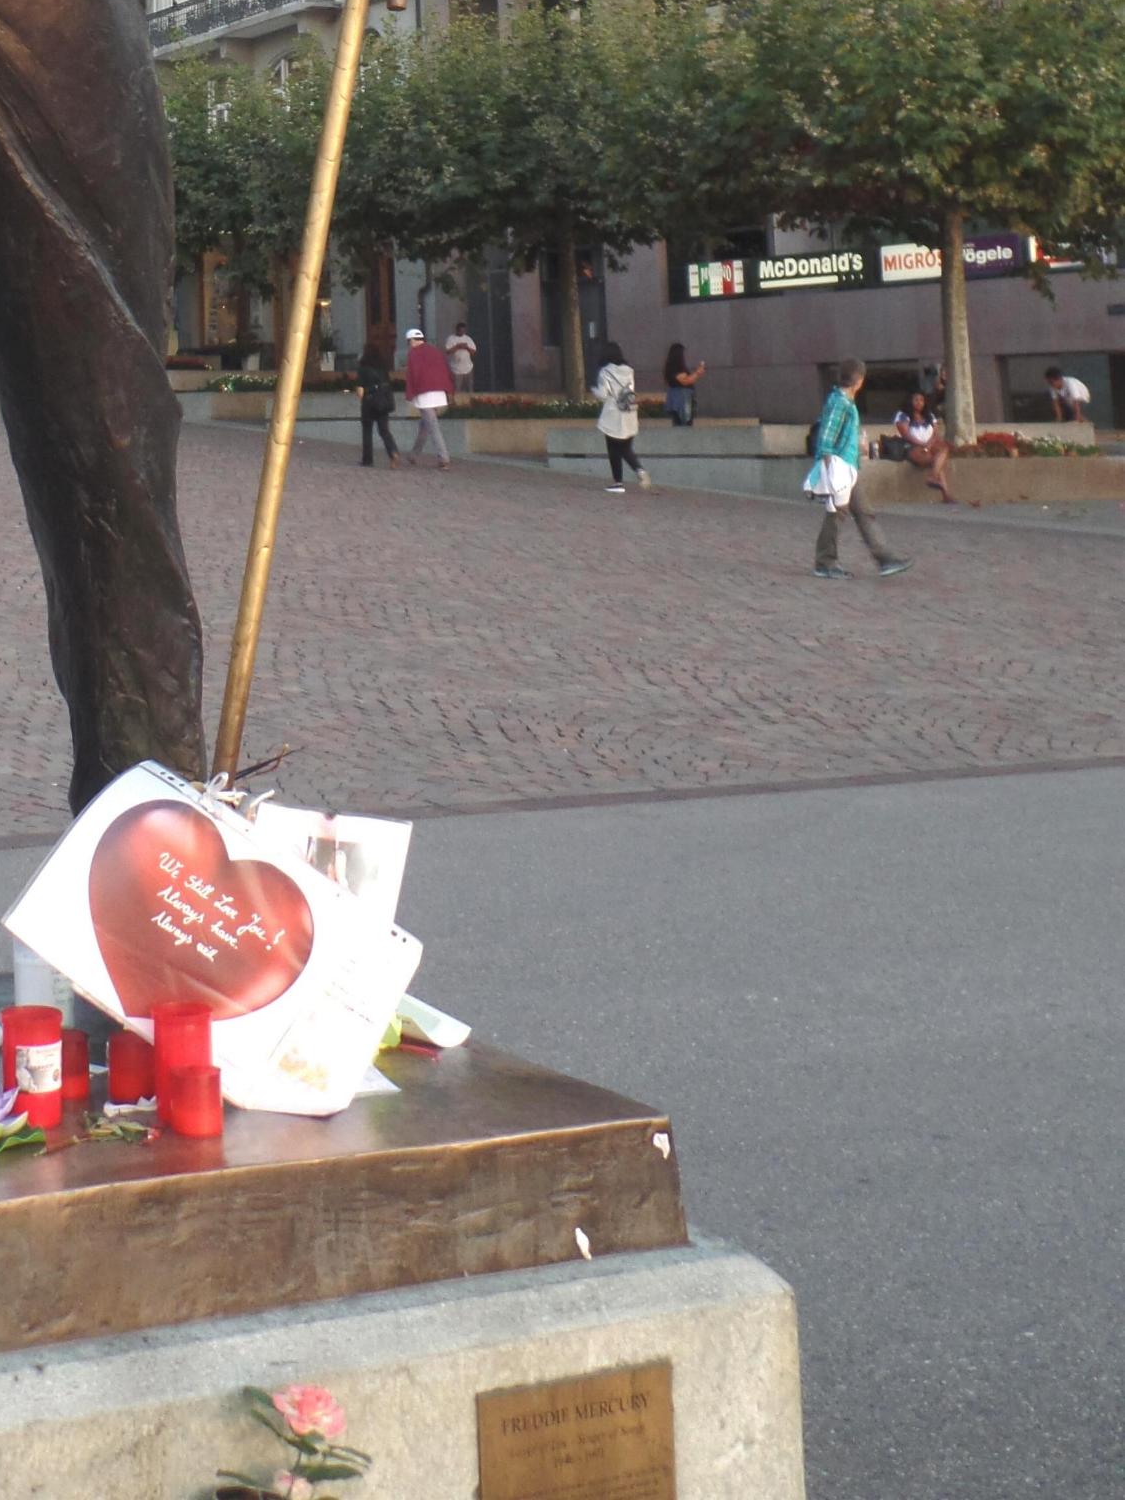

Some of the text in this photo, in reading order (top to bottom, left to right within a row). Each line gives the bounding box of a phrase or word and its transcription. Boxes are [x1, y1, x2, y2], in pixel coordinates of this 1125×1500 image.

[760, 252, 863, 279] McDonald's
[963, 245, 1013, 265] ögele
[160, 852, 184, 878] We
[156, 885, 205, 924] Always
[151, 911, 193, 945] Always
[501, 1392, 651, 1436] FREDDIE MERCURY
